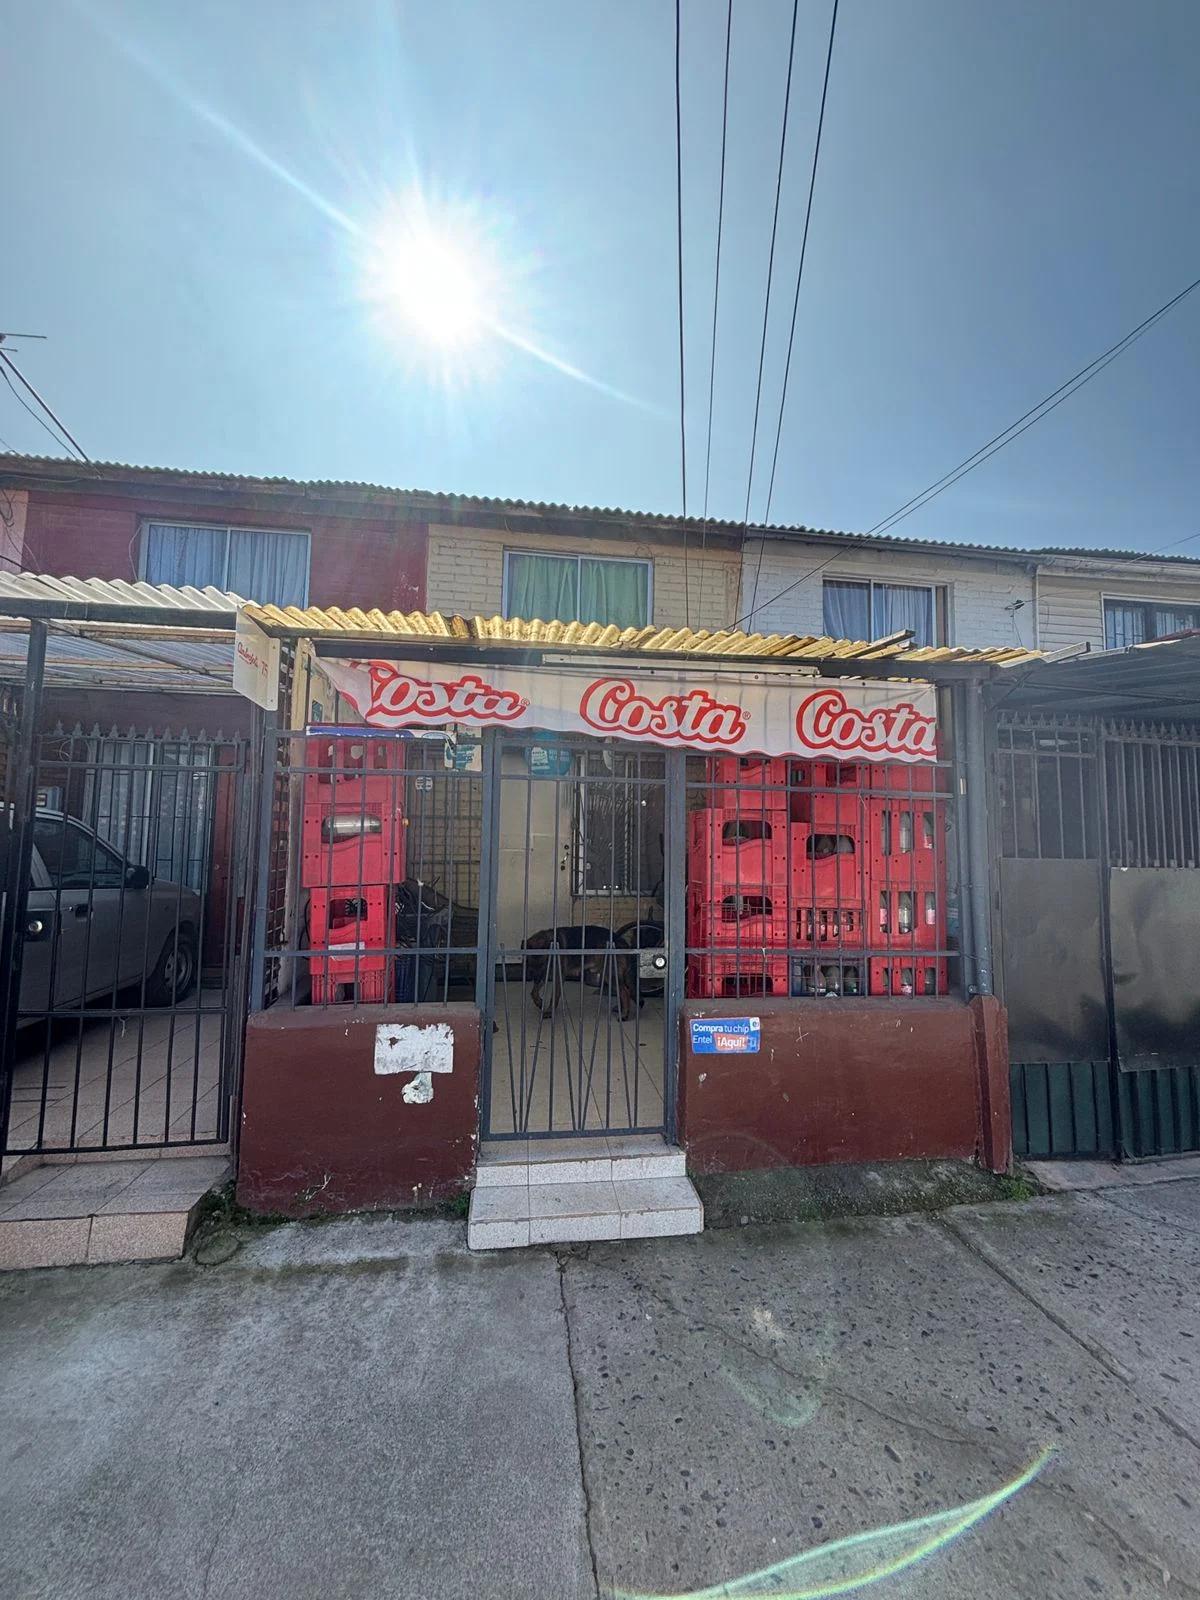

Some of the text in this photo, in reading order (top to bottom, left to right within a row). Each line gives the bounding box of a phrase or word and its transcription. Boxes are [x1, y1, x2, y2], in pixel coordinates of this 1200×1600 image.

[368, 659, 527, 721] osta
[580, 677, 747, 745] Costa
[795, 688, 937, 756] Costa
[693, 1023, 749, 1034] Compra tu chip
[693, 1035, 745, 1048] Entel ¡Aquí!
